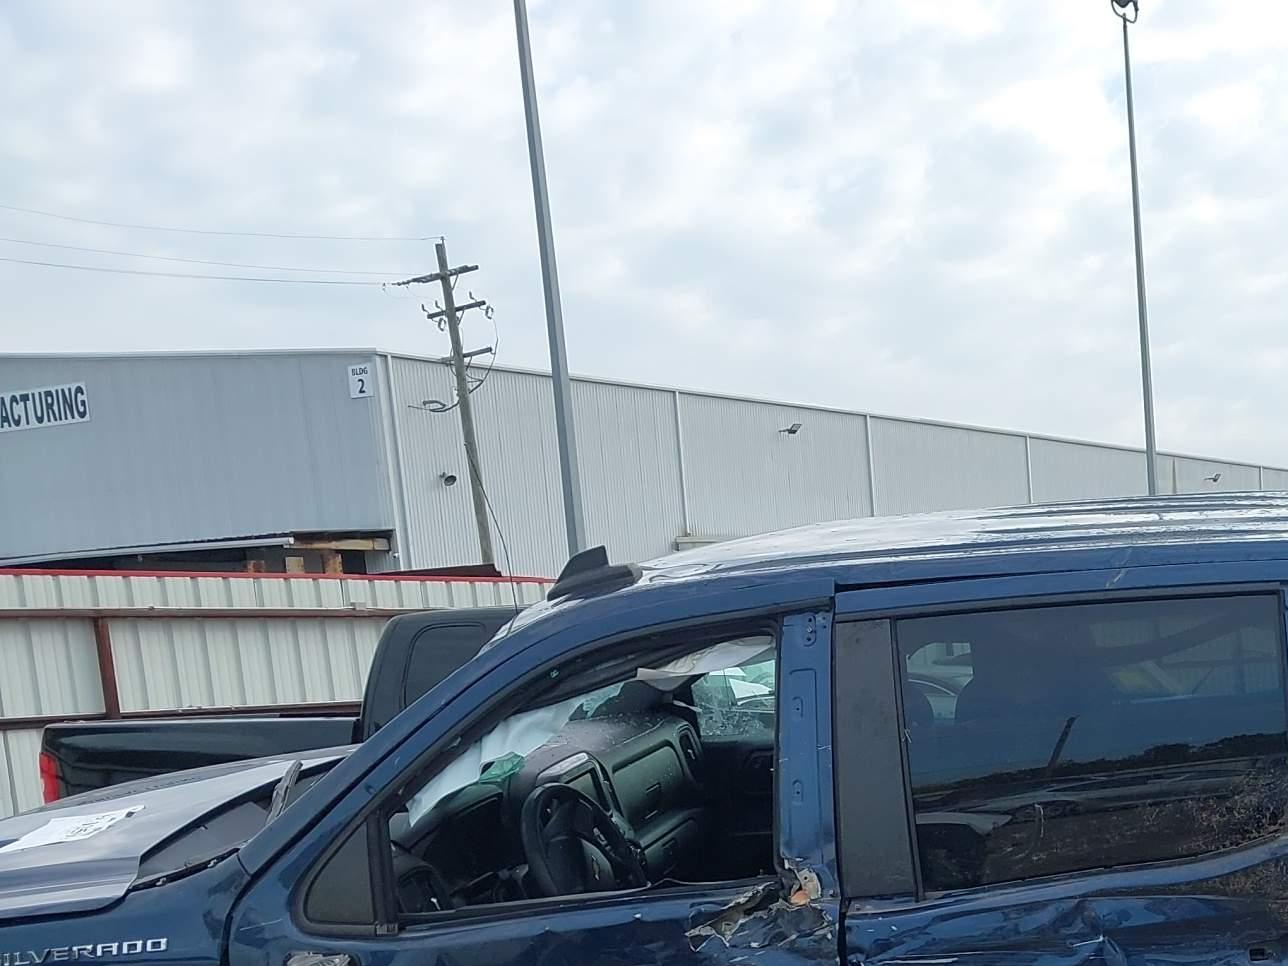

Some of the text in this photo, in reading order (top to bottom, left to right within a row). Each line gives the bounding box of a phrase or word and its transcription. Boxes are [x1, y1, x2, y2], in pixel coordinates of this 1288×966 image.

[351, 366, 369, 377] BLDG
[357, 378, 366, 394] 2
[0, 385, 88, 429] ACTURING
[0, 937, 168, 966] ILVERADO
